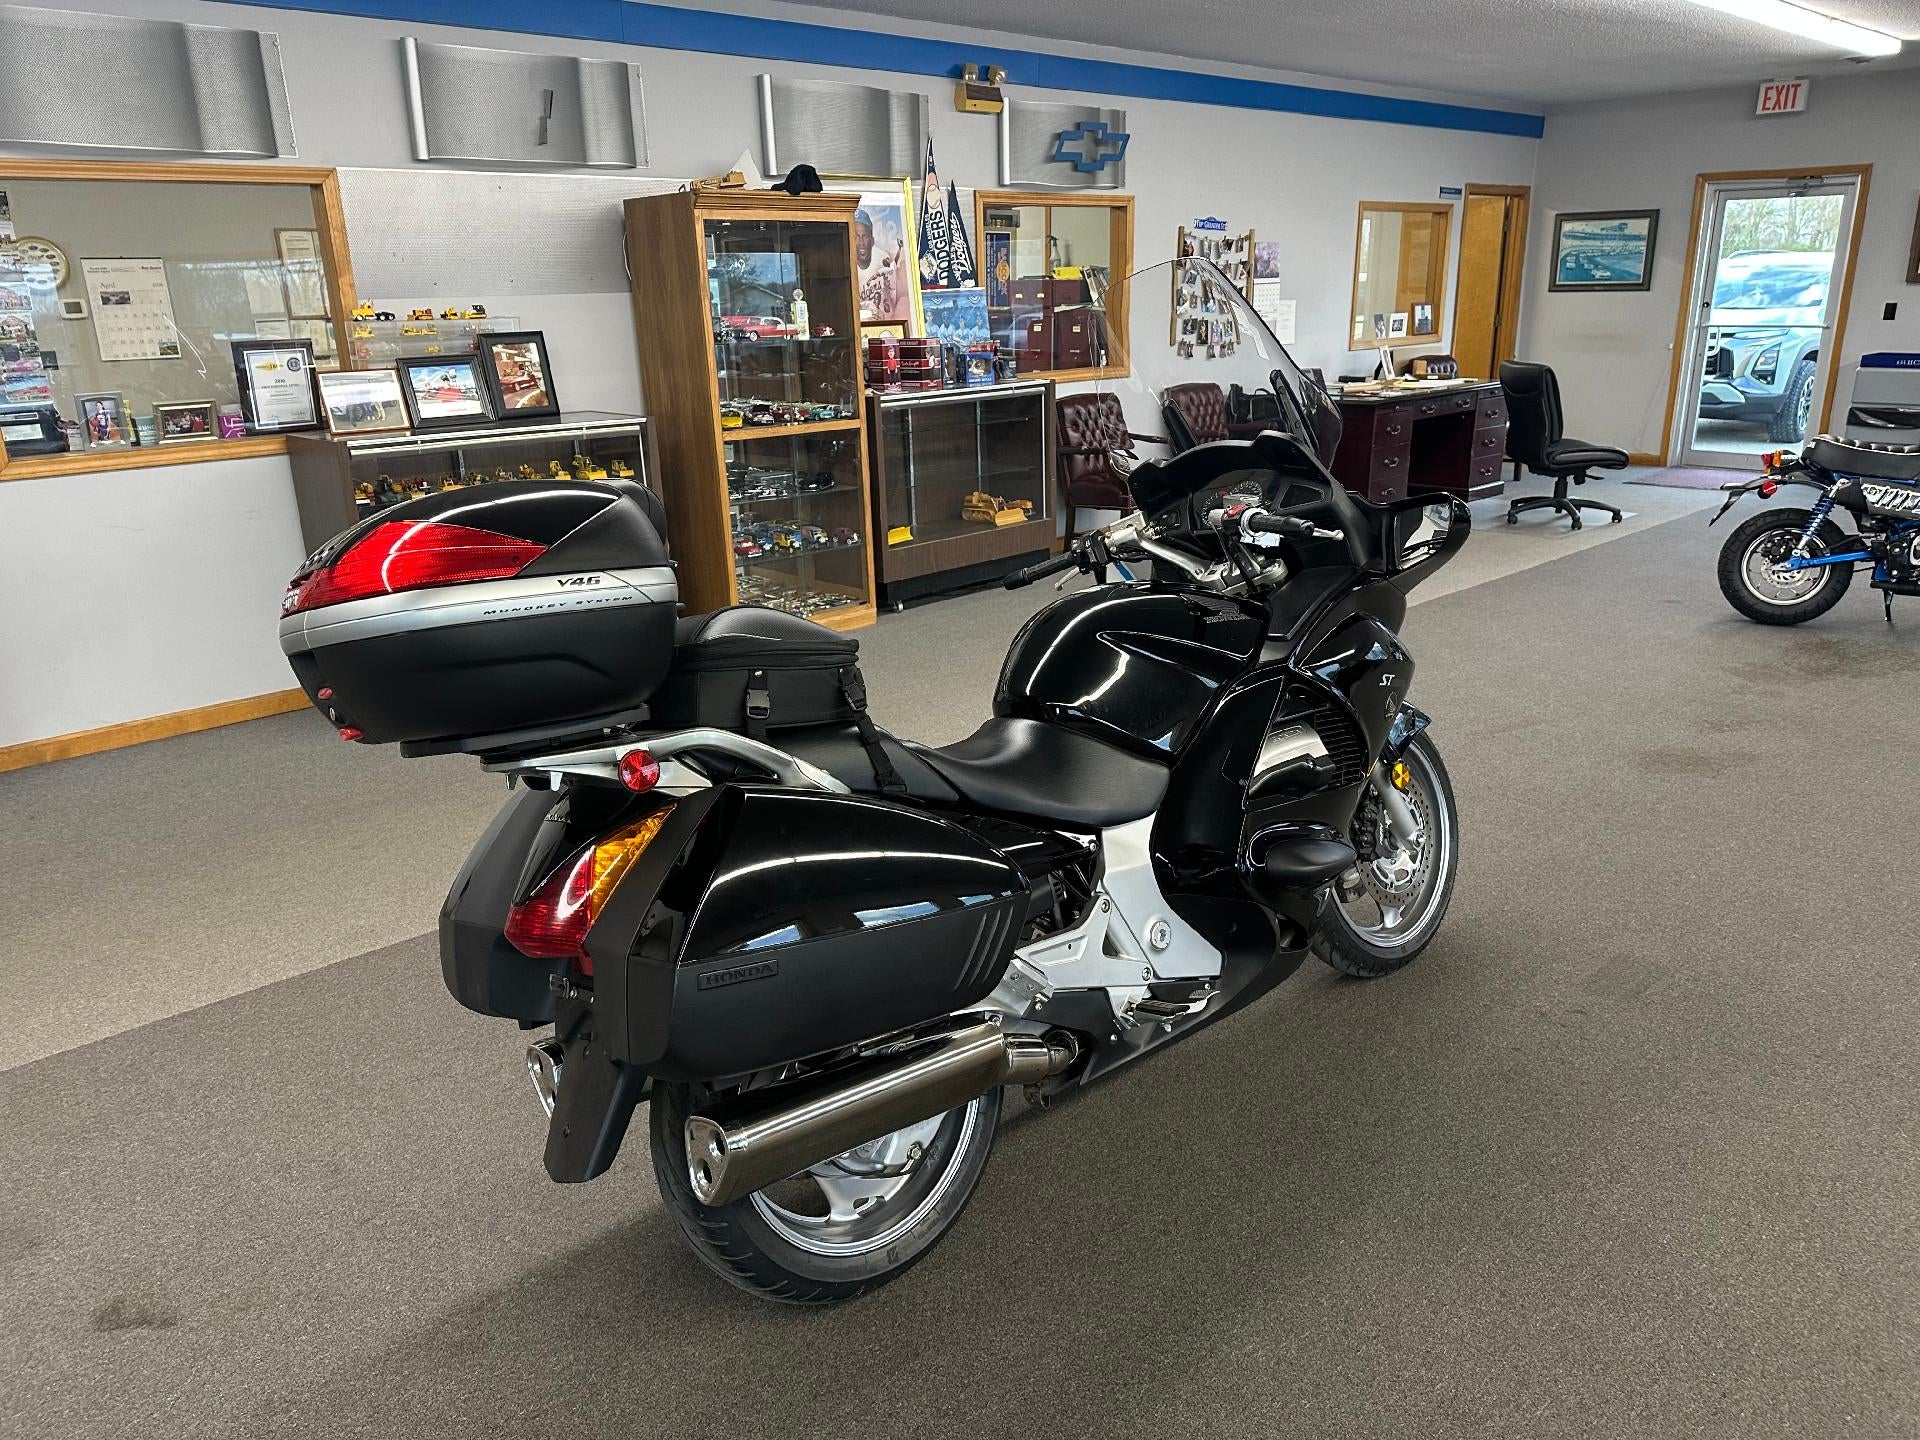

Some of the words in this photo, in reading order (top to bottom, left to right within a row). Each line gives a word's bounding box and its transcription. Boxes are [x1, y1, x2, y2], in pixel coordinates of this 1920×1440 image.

[1762, 84, 1801, 111] EXIT
[929, 211, 951, 281] DODGERS
[950, 212, 972, 274] Dodgers
[1000, 247, 1008, 295] BABCOCK
[575, 595, 634, 606] SYSTEM
[1379, 673, 1396, 686] ST
[705, 964, 775, 986] HONDA
